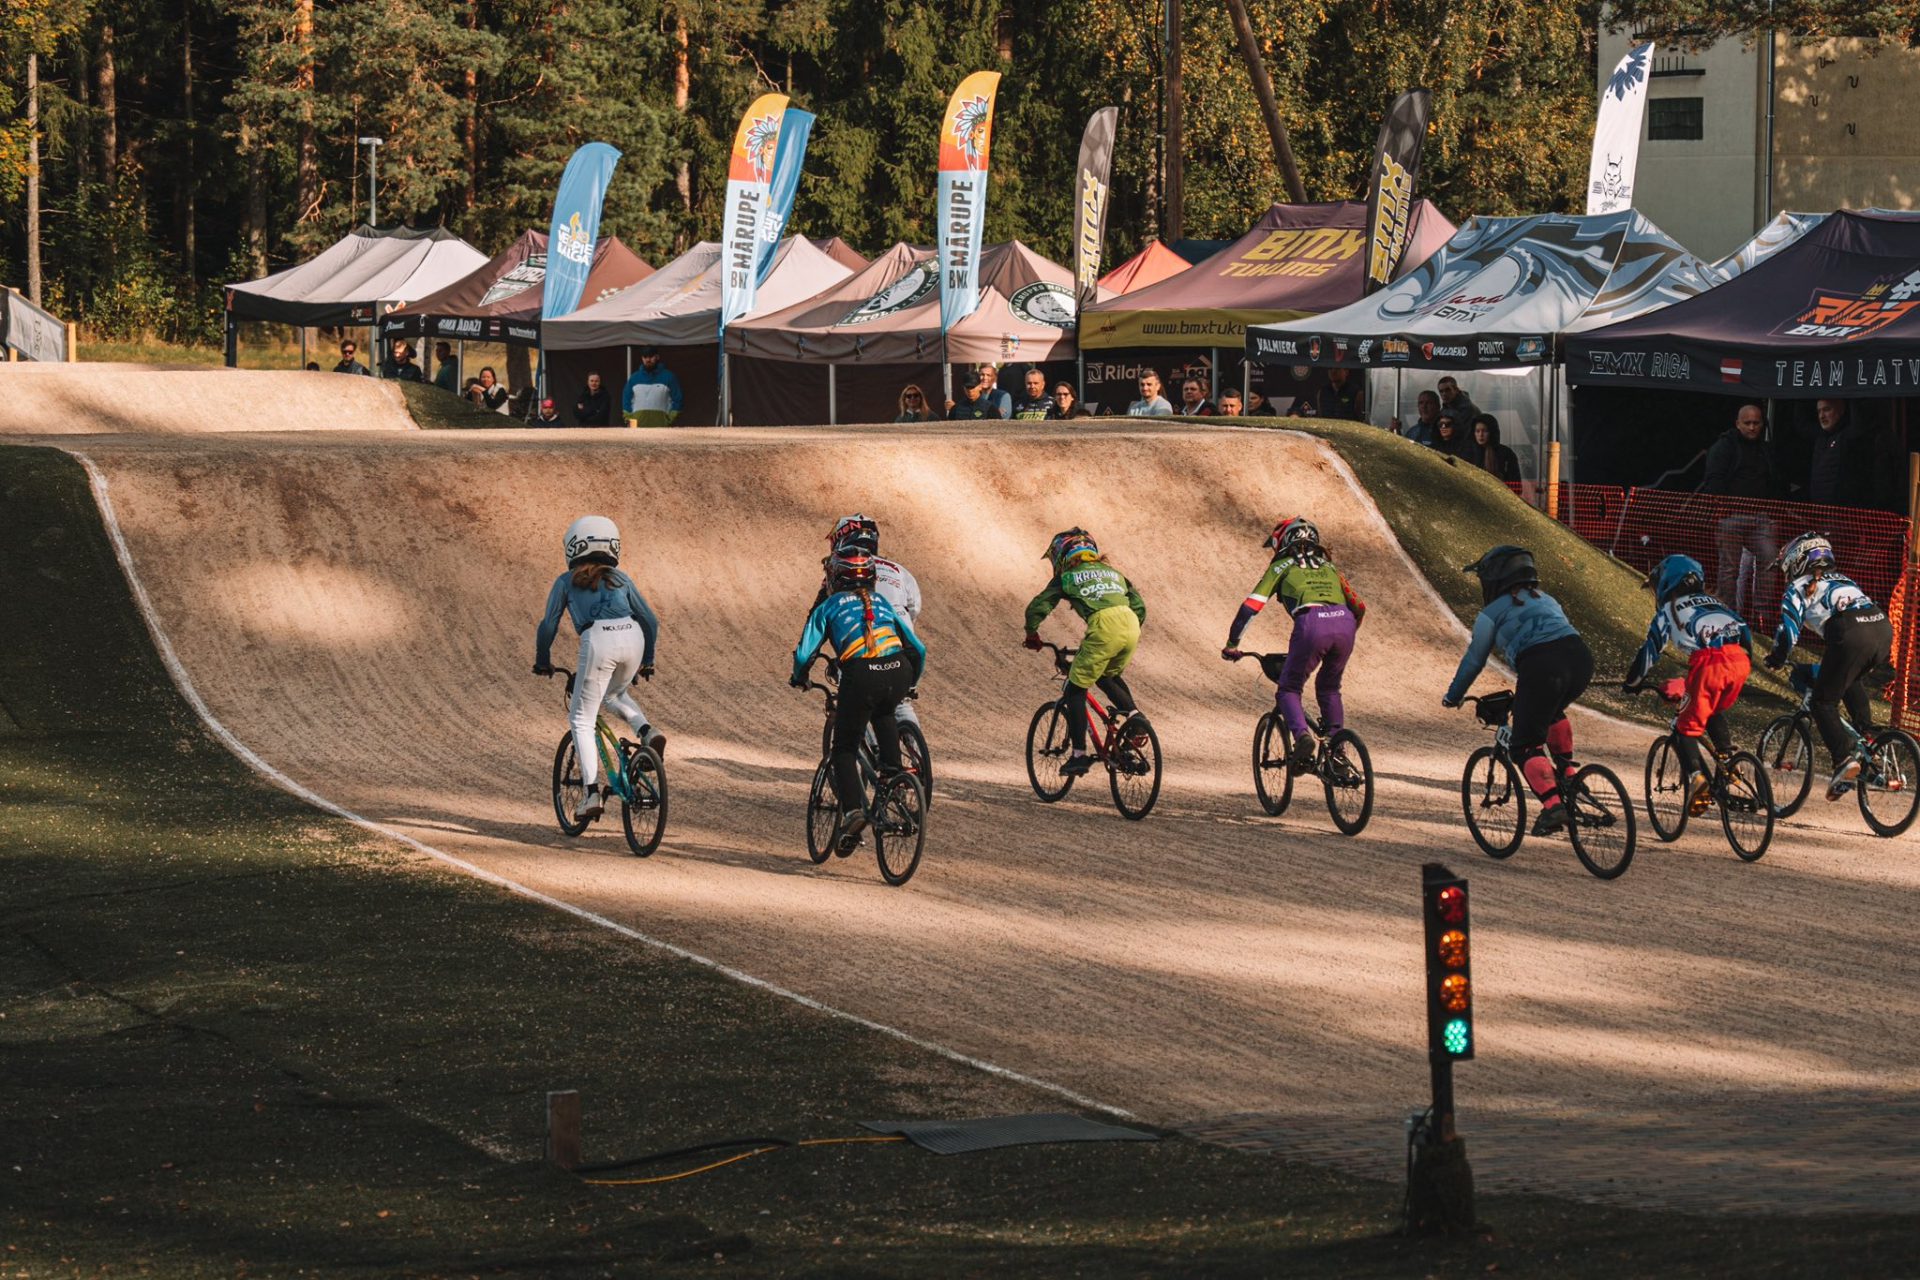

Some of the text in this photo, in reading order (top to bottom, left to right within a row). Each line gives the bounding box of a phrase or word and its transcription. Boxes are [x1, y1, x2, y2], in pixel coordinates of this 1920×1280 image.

[729, 189, 760, 269] MĀRUPE
[946, 180, 973, 289] BMX MĀRUPE
[1241, 228, 1367, 260] BMX
[1219, 262, 1338, 278] TUKUMS
[1433, 305, 1485, 322] BMX
[1784, 324, 1862, 337] BMX
[1256, 338, 1298, 356] VALMIERA
[1589, 351, 1690, 379] BMX RIGA
[1776, 361, 1844, 387] TEAM
[869, 660, 900, 671] NOLOGO
